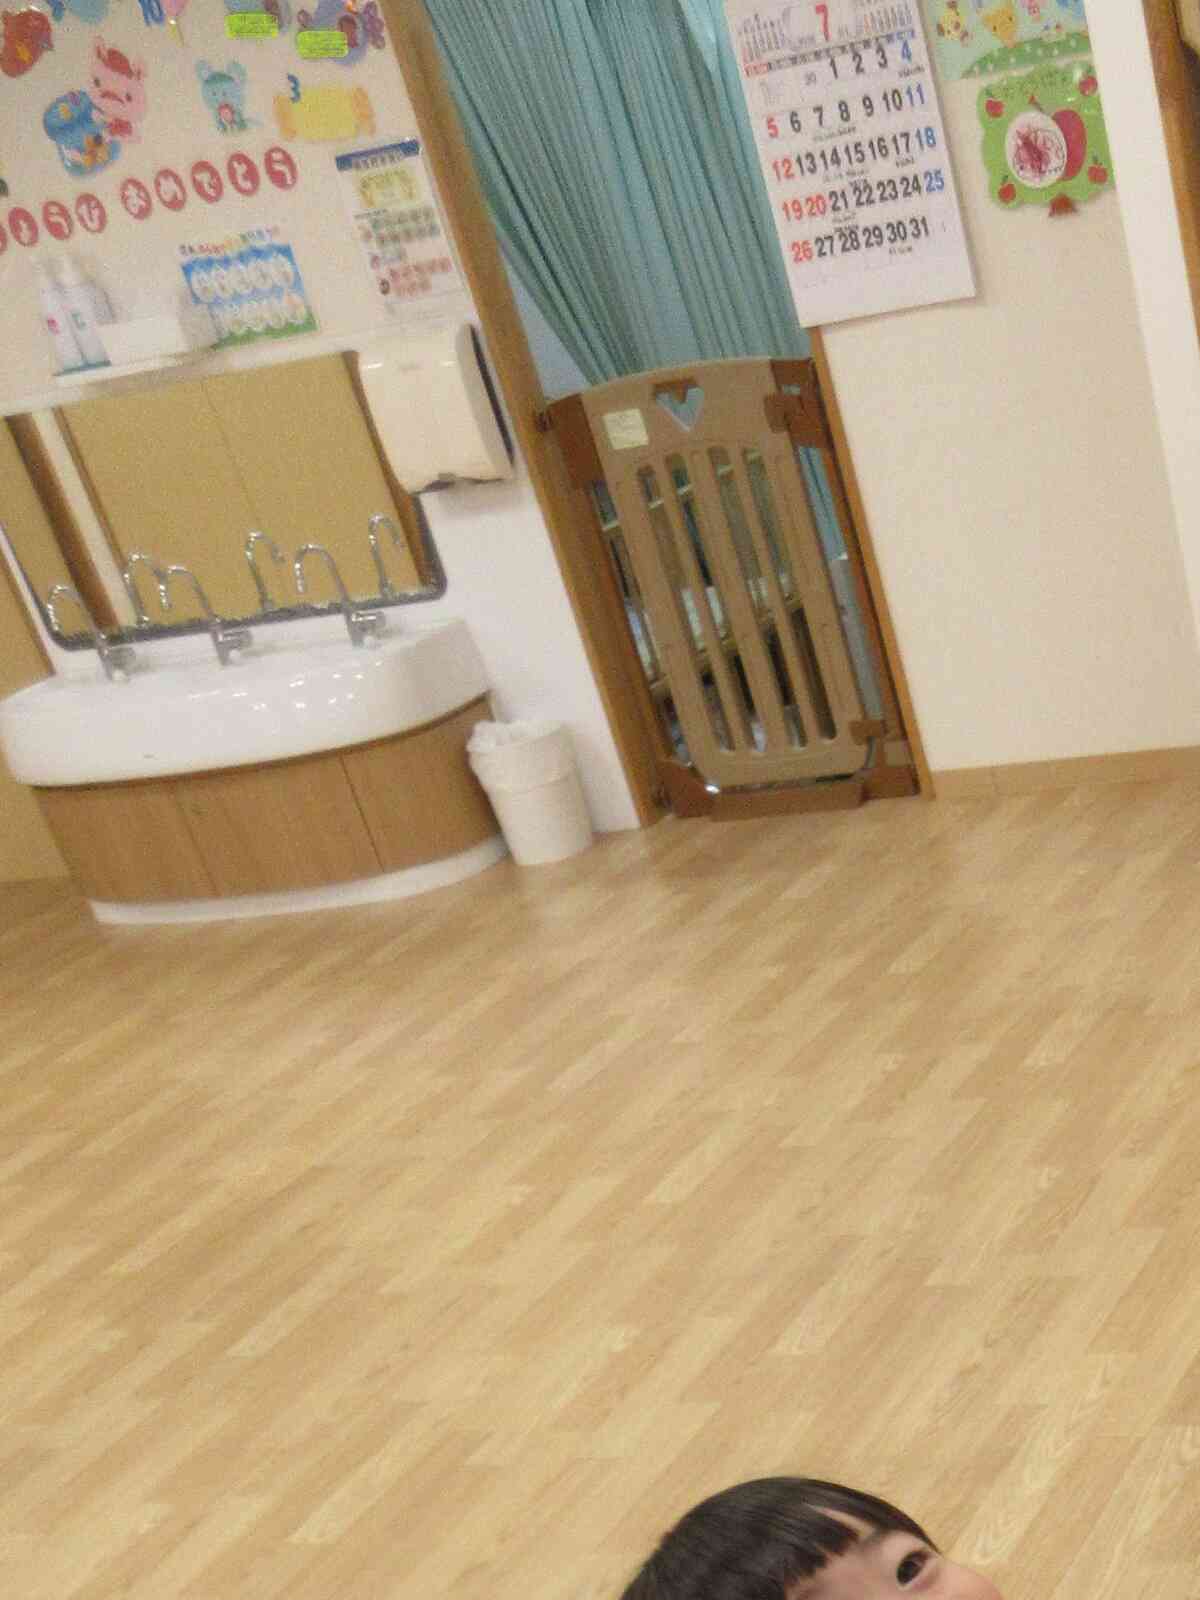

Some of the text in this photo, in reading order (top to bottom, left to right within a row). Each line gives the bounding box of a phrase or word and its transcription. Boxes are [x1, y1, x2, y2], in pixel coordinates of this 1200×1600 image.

[815, 4, 832, 42] 7
[830, 57, 839, 80] 1
[852, 52, 865, 75] 2
[876, 45, 888, 69] 3
[901, 40, 912, 62] 4
[766, 83, 925, 139] 5 6 7 8 9 10 11
[772, 158, 794, 182] 12
[795, 151, 817, 176] 13
[819, 145, 842, 171] 14
[844, 140, 865, 166] 15
[868, 135, 889, 161] 16
[892, 131, 911, 155] 17
[915, 126, 937, 151] 18
[782, 199, 804, 222] 19
[805, 193, 827, 217] 20
[829, 189, 850, 212] 21
[852, 184, 876, 208] 22
[876, 179, 900, 203] 23
[900, 174, 922, 198] 24
[923, 169, 945, 193] 25
[791, 240, 814, 264] 26
[814, 235, 835, 258] 27
[838, 229, 861, 253] 28
[862, 225, 884, 249] 29
[885, 220, 908, 244] 30
[909, 215, 930, 240] 31
